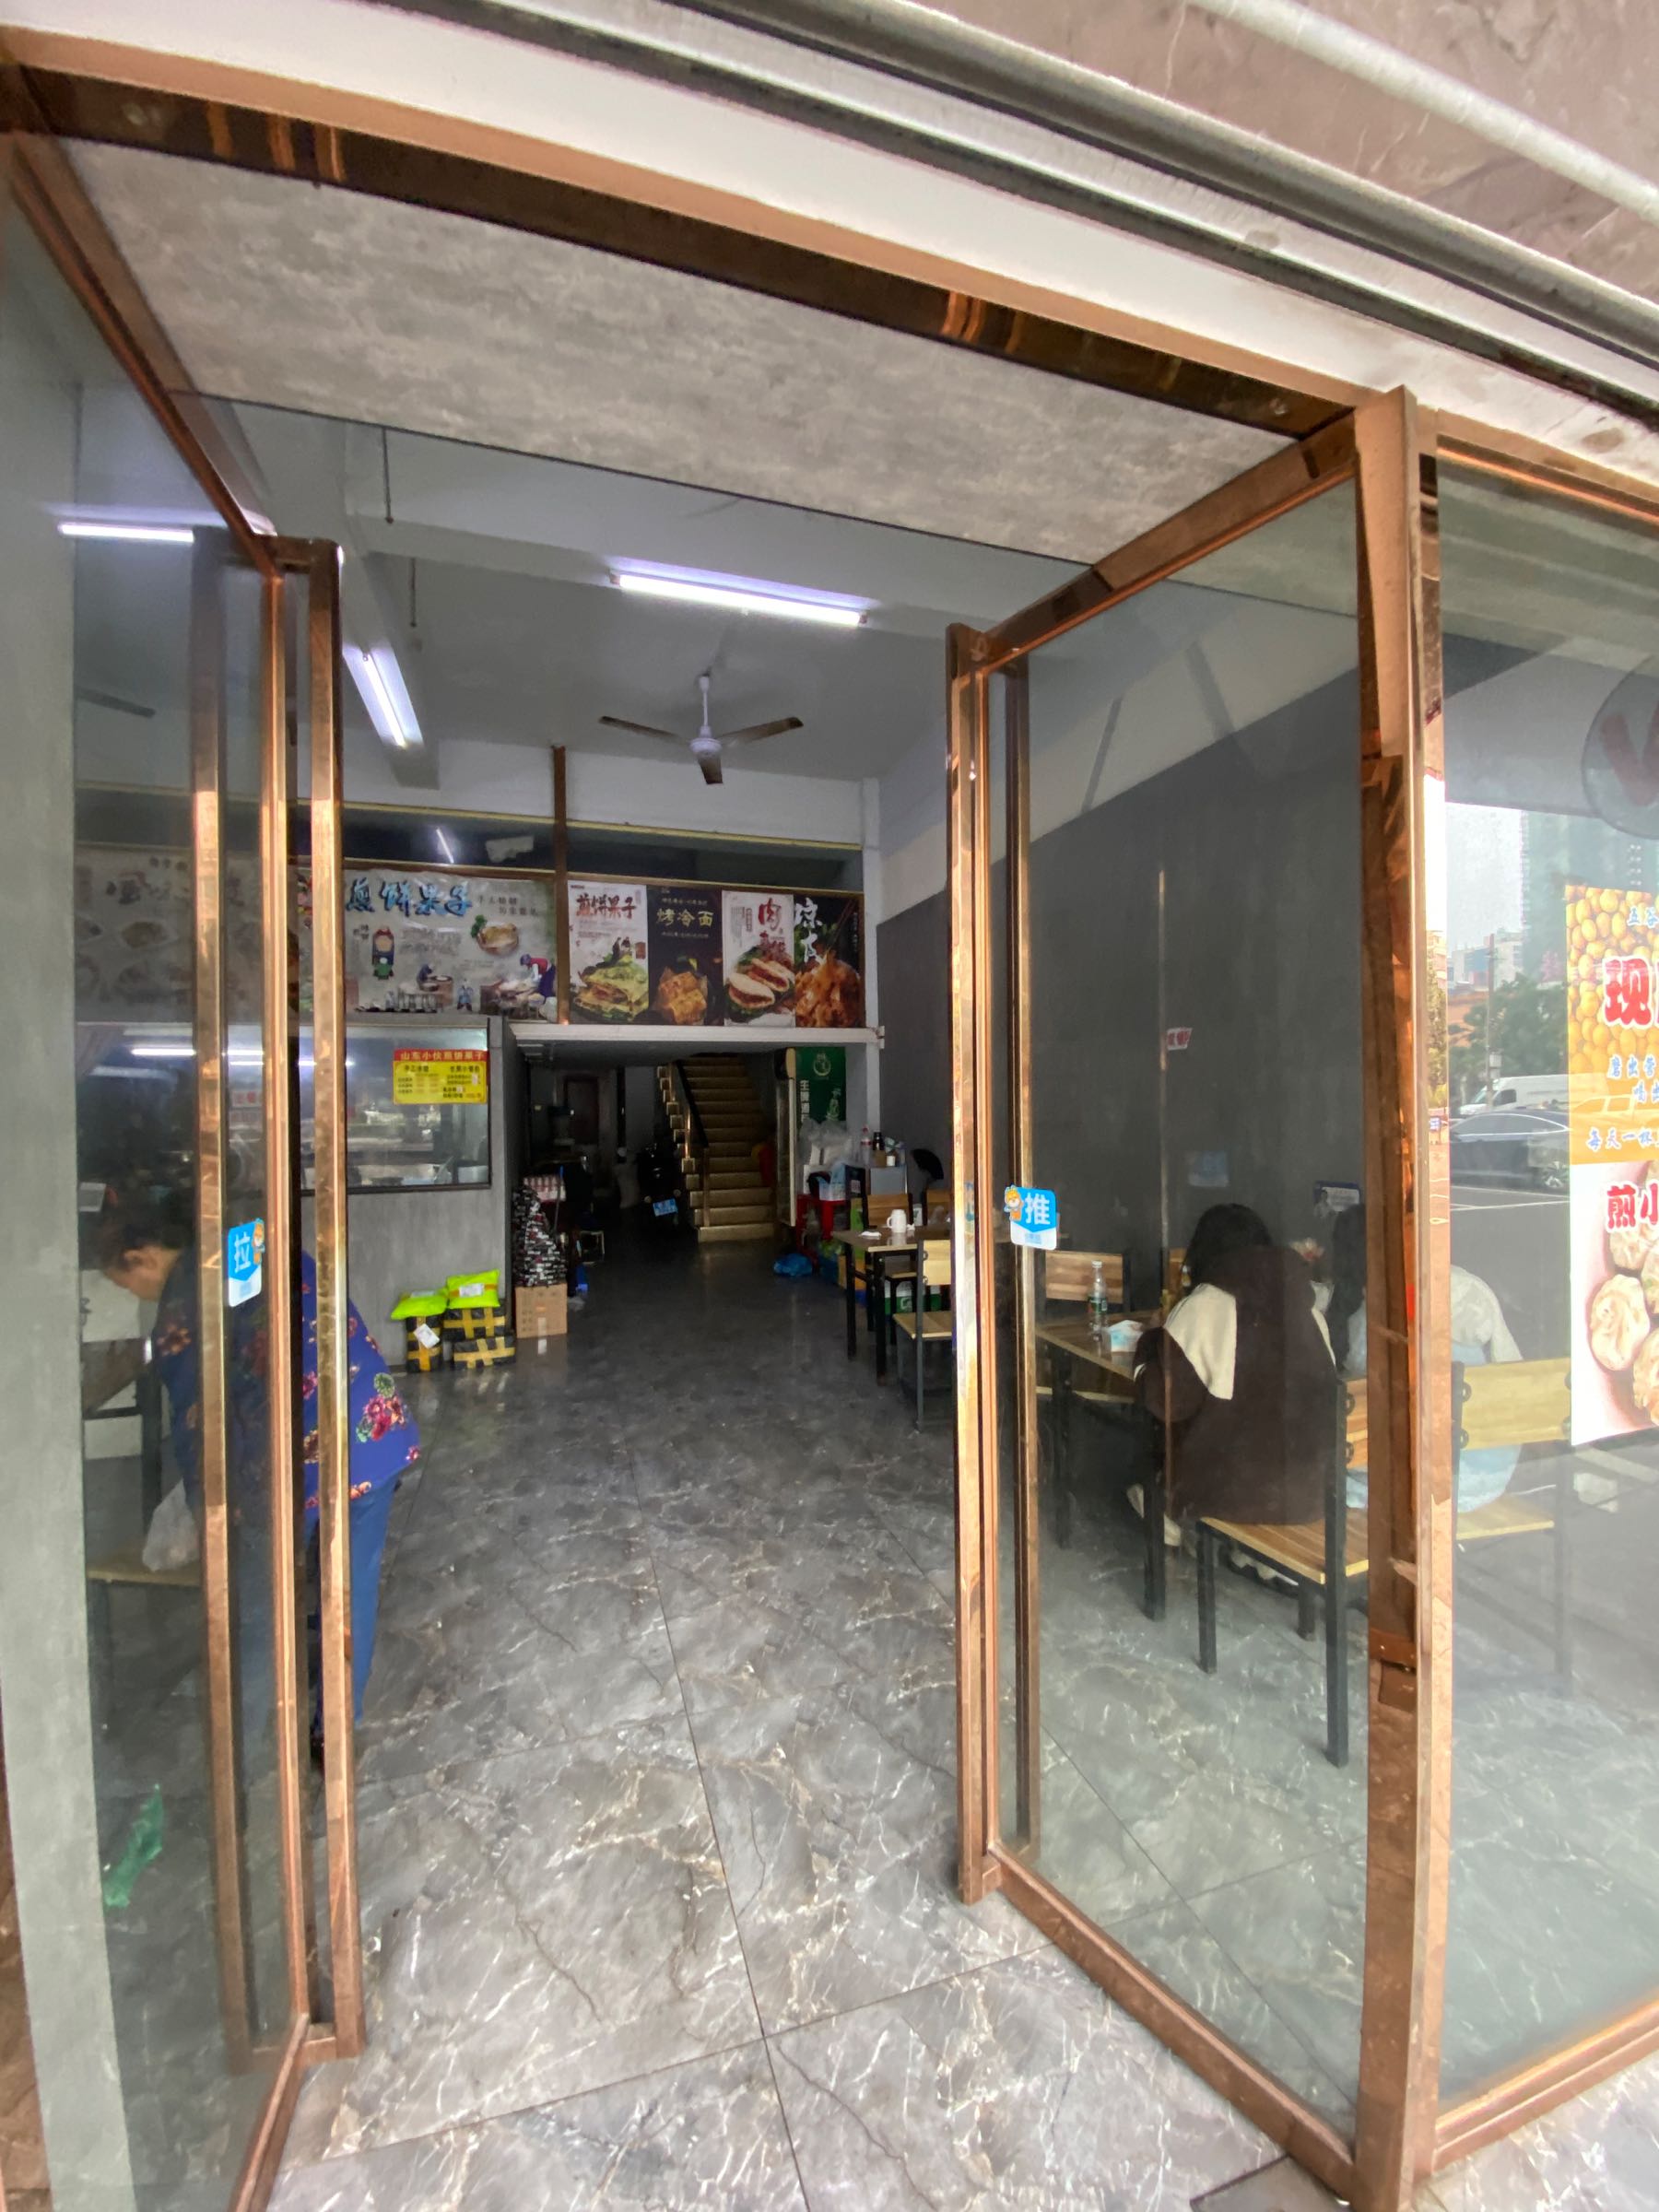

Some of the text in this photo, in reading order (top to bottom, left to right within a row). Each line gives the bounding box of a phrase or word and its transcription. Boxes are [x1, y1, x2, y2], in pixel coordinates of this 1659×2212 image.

[346, 877, 472, 917] 煎饼果子
[576, 892, 637, 920] 煎饼果子
[656, 907, 714, 929] 烤冷面
[1604, 956, 1659, 1028] 现
[1607, 1054, 1655, 1079] 磨出营
[1586, 1127, 1659, 1150] 每天一杯
[1024, 1192, 1051, 1225] 推
[1606, 1182, 1659, 1229] 煎小
[234, 1230, 252, 1273] 拉
